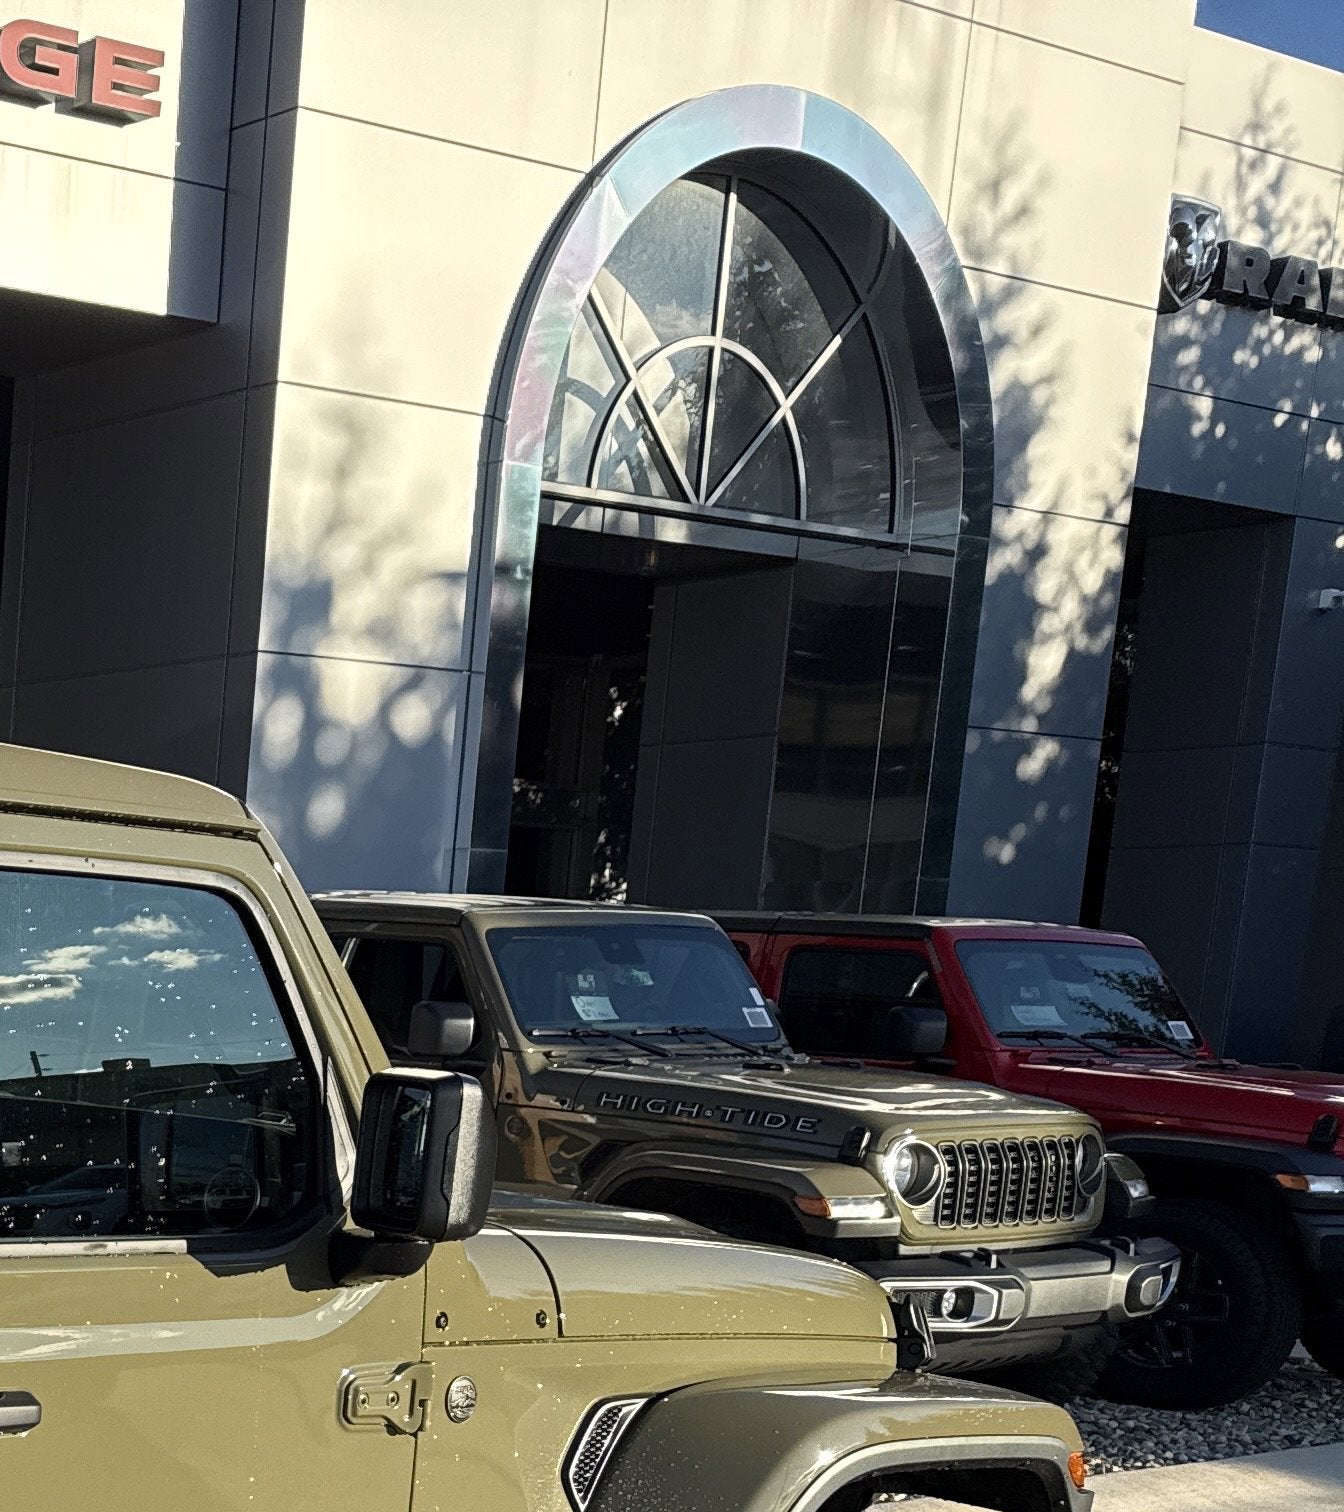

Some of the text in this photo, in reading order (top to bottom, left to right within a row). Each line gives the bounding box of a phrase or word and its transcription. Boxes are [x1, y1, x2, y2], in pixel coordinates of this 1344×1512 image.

[1220, 241, 1344, 319] RA
[598, 1092, 820, 1134] HIGH TIDE
